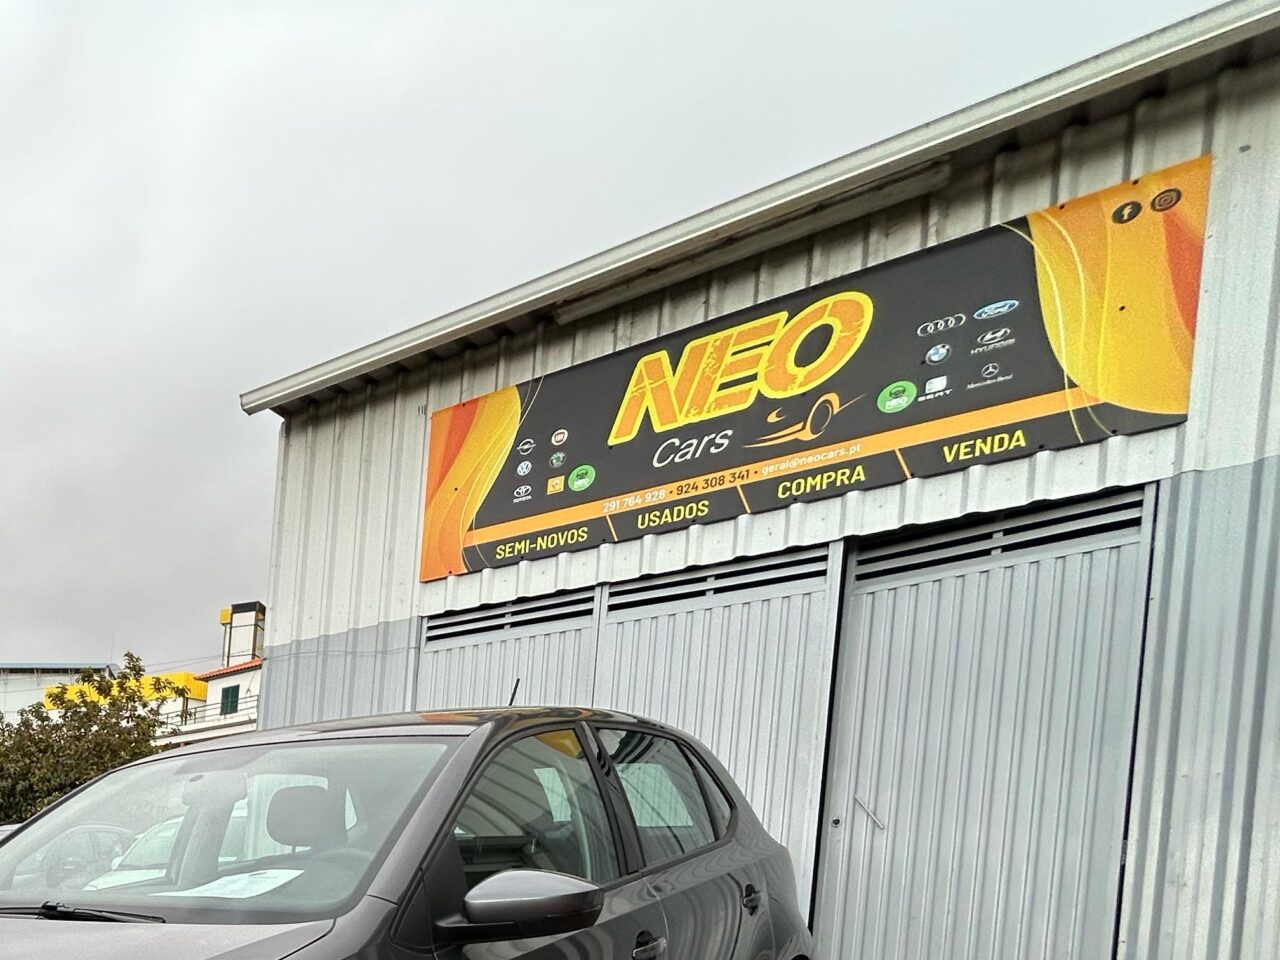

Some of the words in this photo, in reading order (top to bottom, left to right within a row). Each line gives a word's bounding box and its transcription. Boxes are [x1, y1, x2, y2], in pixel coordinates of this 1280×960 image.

[608, 291, 874, 446] NEO
[918, 389, 953, 402] SEAT
[652, 429, 733, 468] Cars
[943, 430, 1026, 464] VENDA
[602, 501, 620, 513] 291
[622, 496, 643, 509] 764
[645, 490, 666, 504] 928
[676, 483, 699, 496] 924
[702, 476, 726, 490] 308
[729, 469, 751, 484] 341
[761, 443, 862, 475] geral@neocars.pt
[777, 465, 866, 499] COMPRA
[637, 500, 710, 529] USADOS
[495, 526, 589, 560] SEMI-NOVOS
